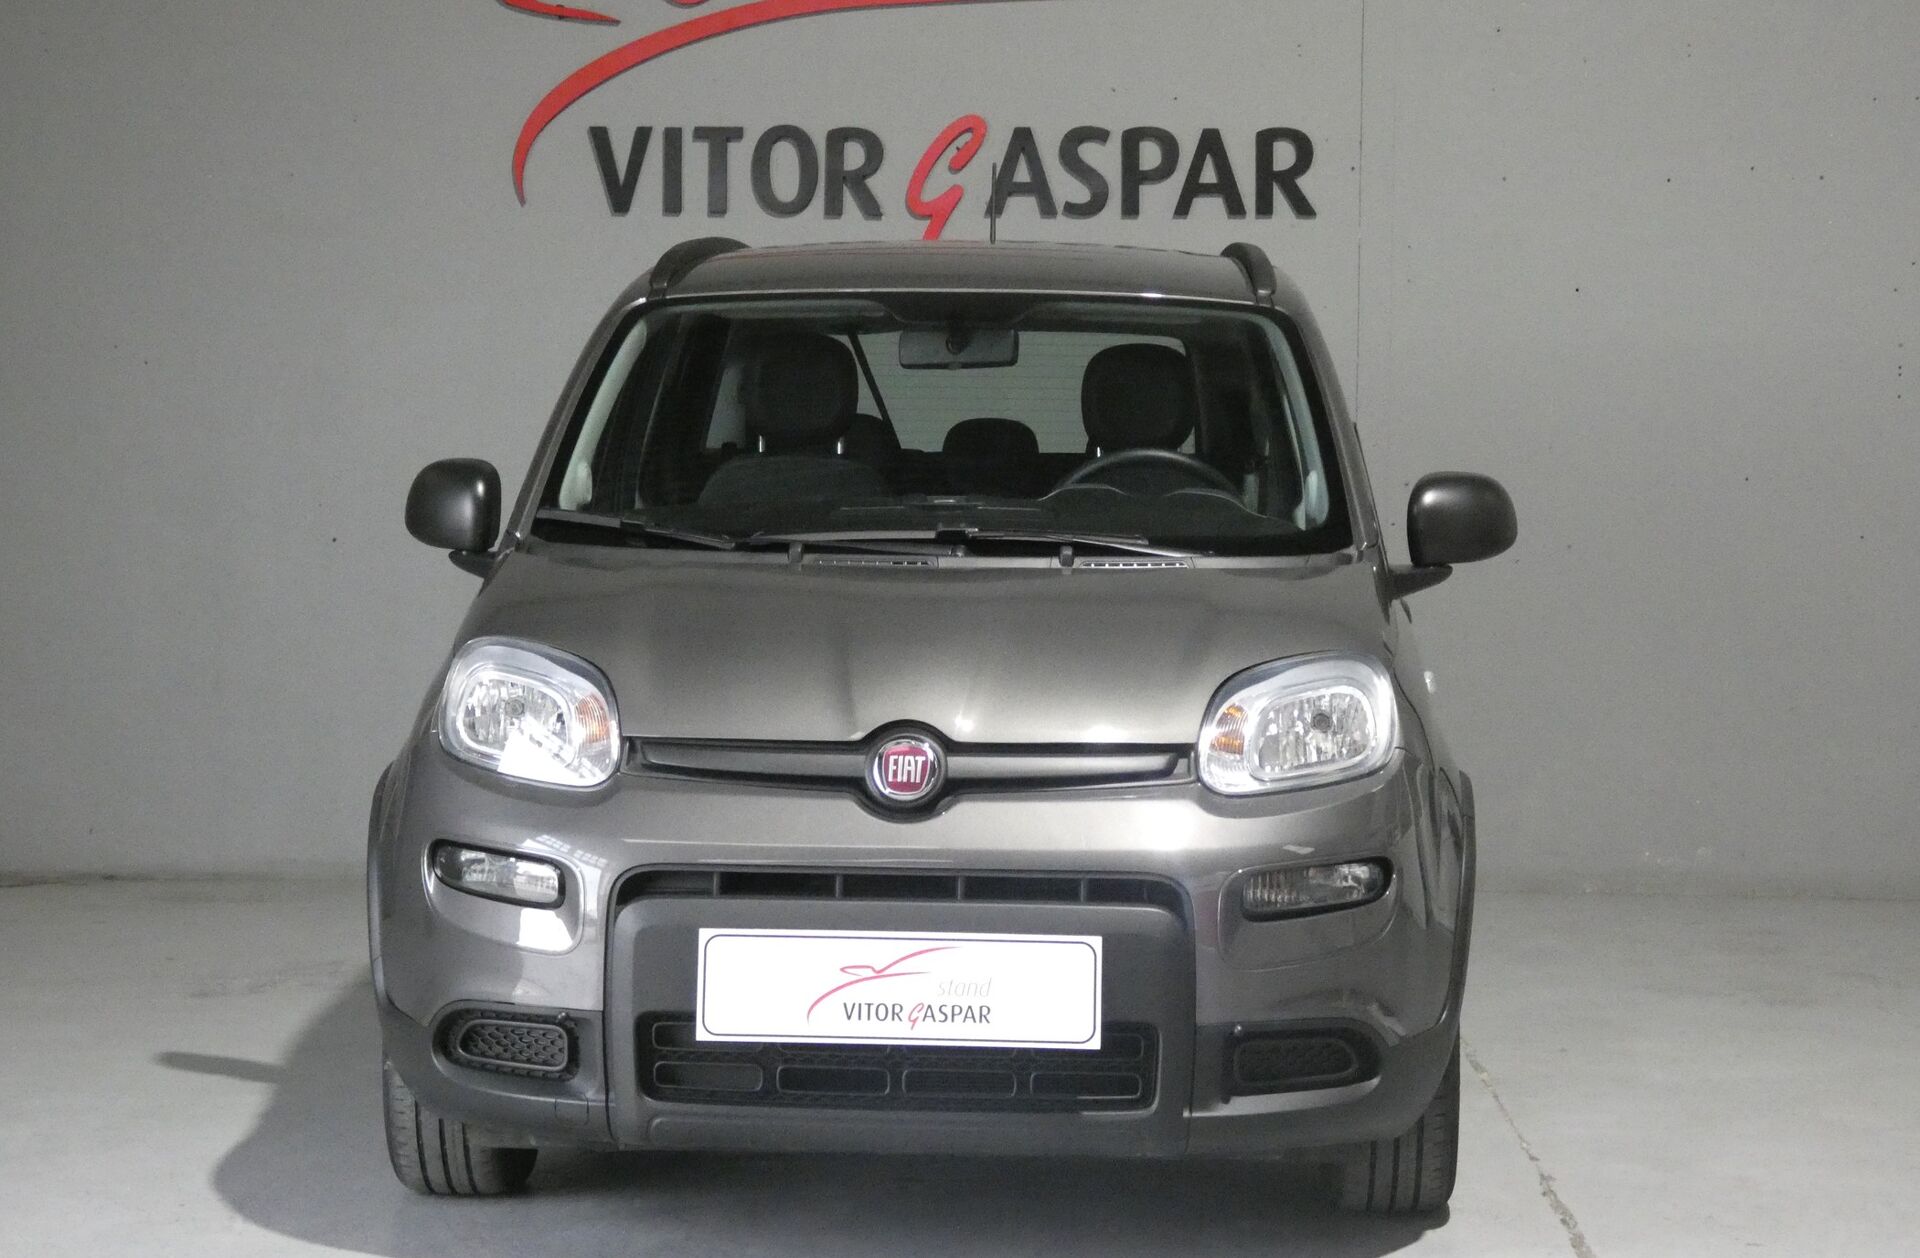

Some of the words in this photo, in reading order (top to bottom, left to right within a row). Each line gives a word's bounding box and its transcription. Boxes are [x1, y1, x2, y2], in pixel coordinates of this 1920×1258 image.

[589, 124, 885, 219] VITOR
[906, 114, 1318, 241] GASPAR
[888, 755, 926, 783] FIAT
[938, 978, 991, 997] stand
[843, 1002, 903, 1022] VITOR
[908, 1003, 991, 1030] GASPAR
